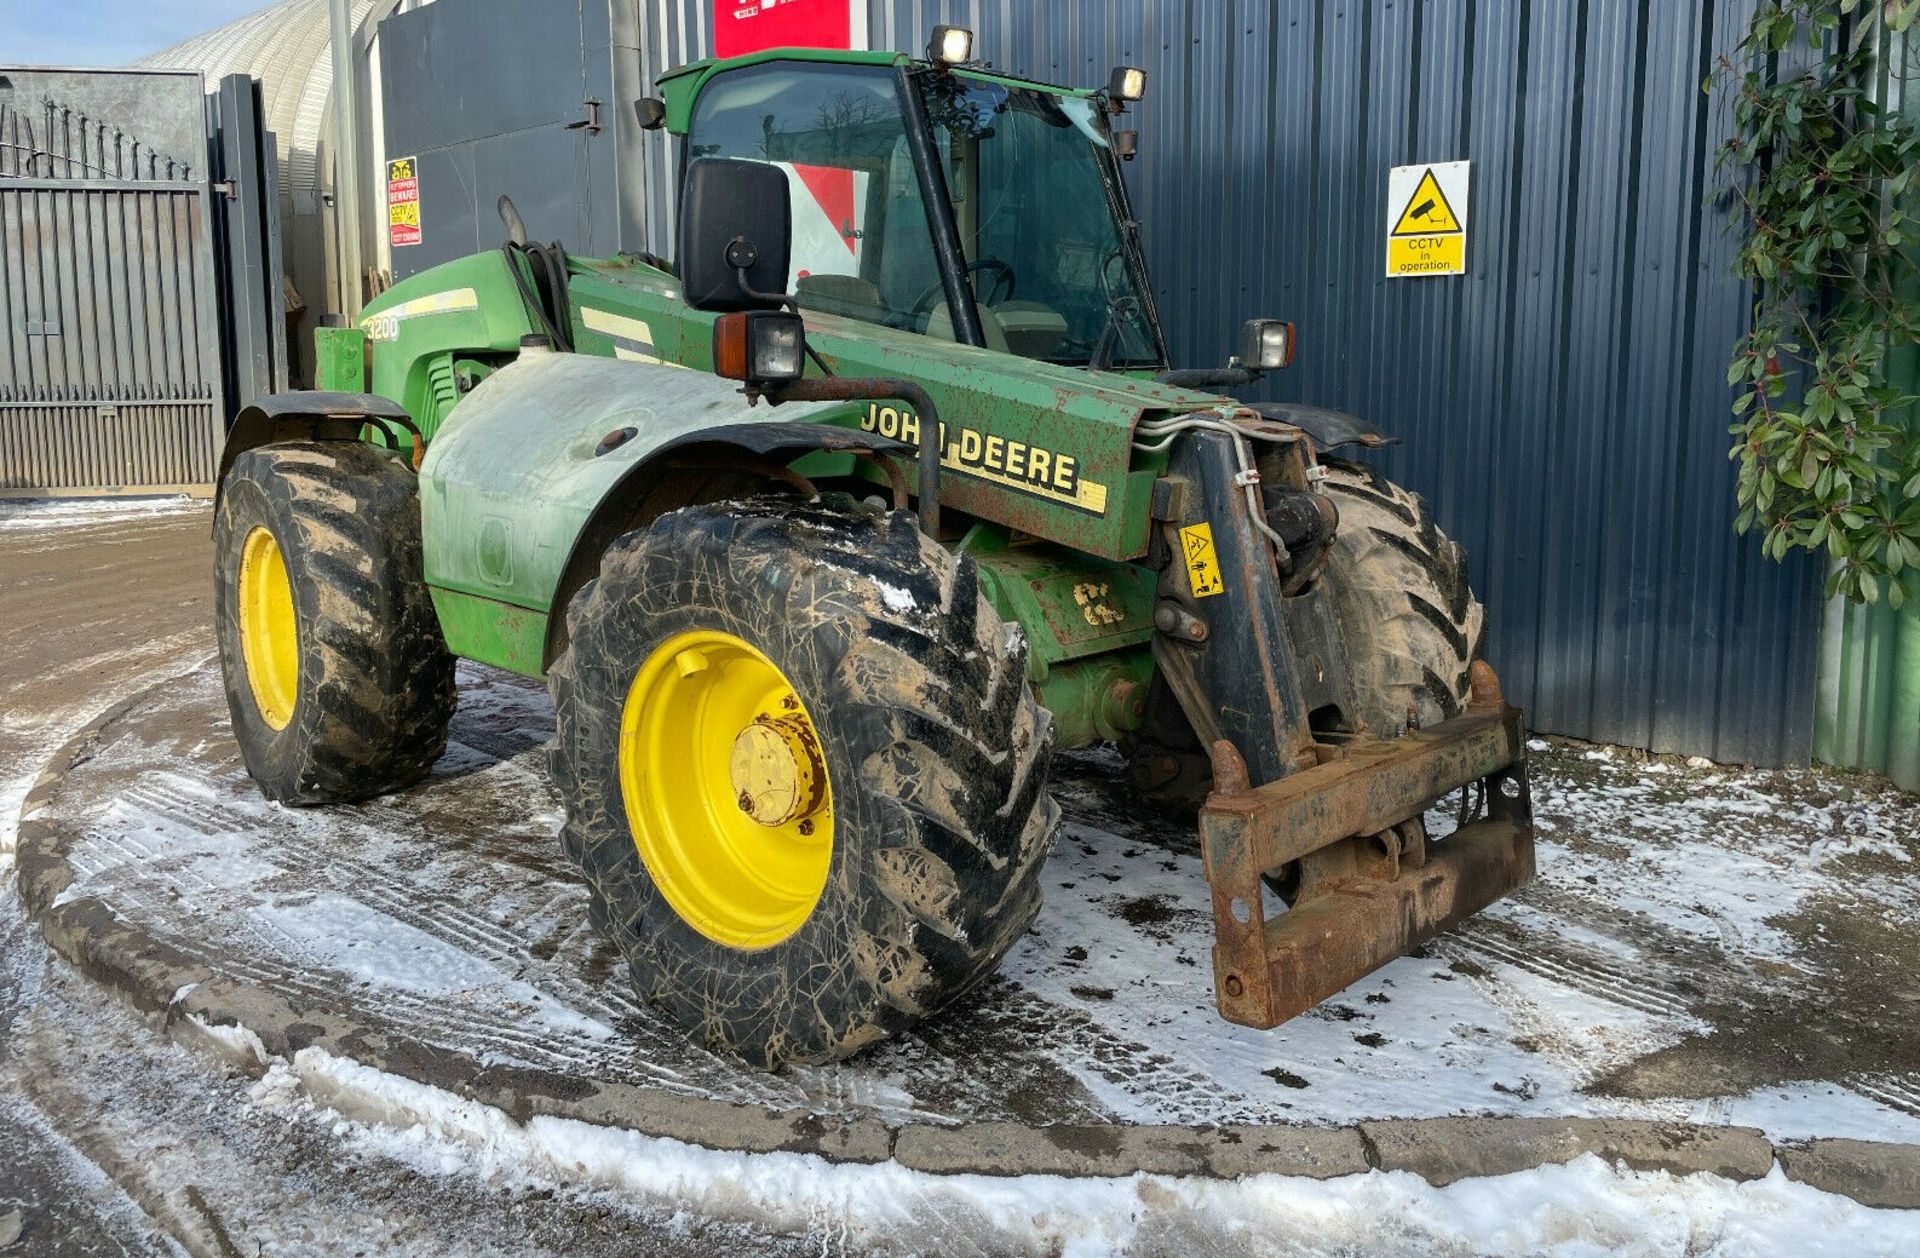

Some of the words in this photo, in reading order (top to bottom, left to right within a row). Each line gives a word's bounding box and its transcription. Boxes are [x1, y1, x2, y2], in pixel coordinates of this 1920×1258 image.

[391, 205, 407, 216] CCTV
[1408, 238, 1444, 249] CCTV
[1420, 252, 1430, 260] in
[1400, 260, 1450, 272] operation
[367, 317, 399, 340] 3200
[960, 428, 1076, 490] DEERE
